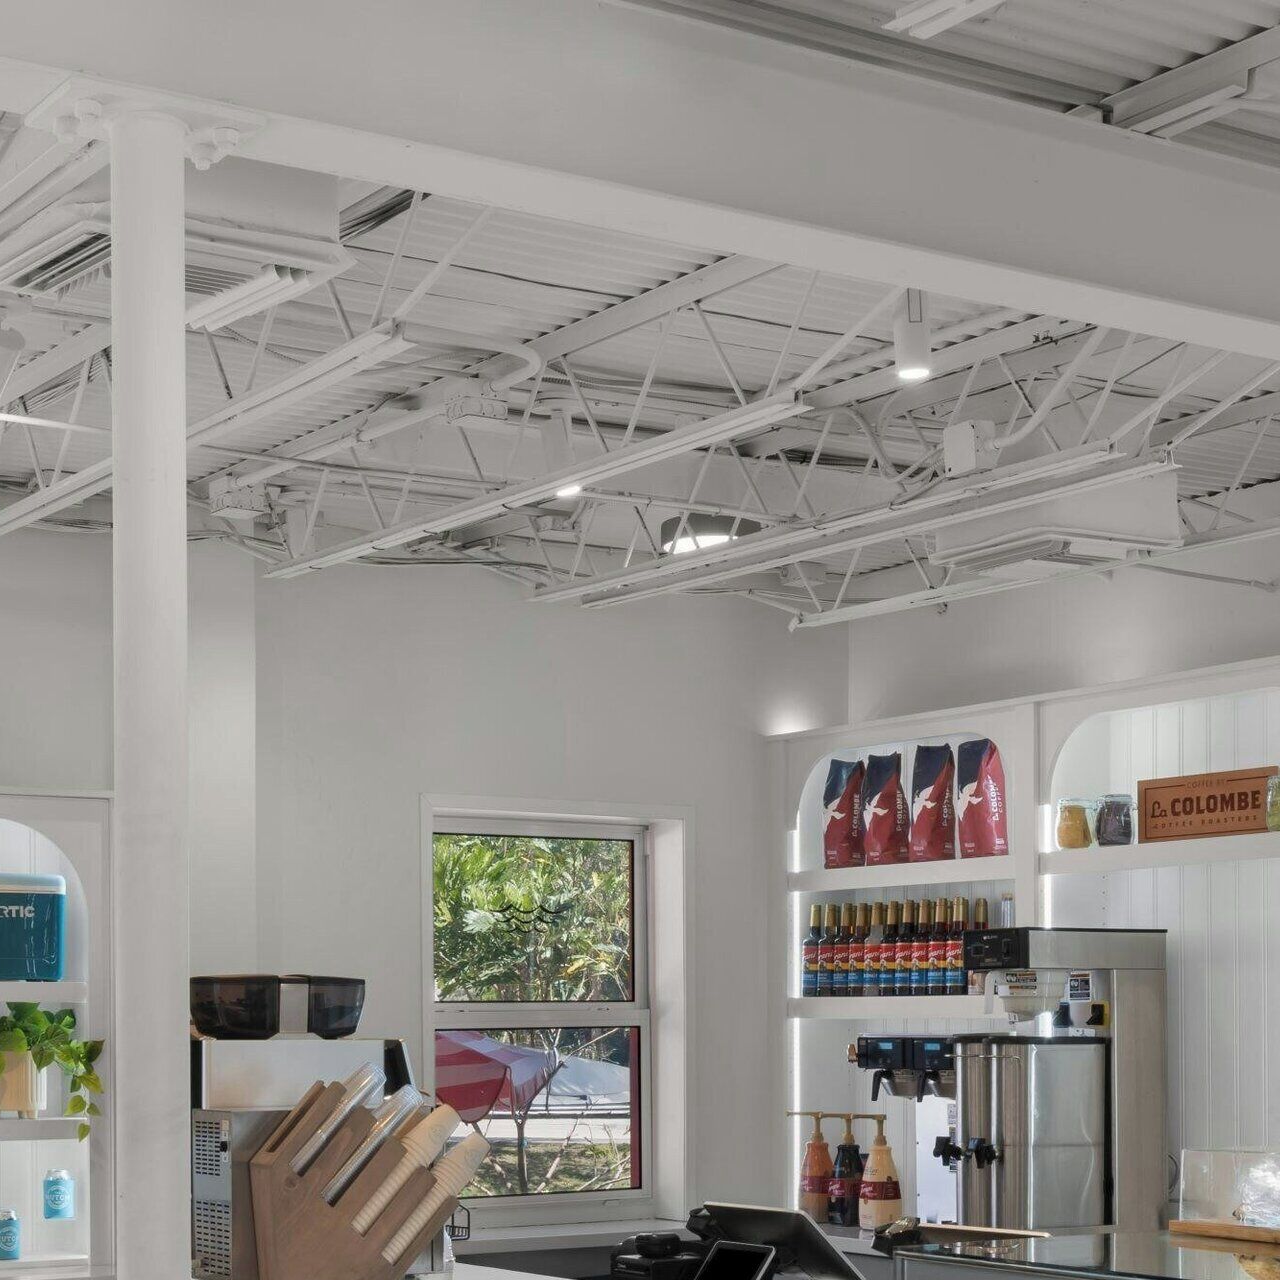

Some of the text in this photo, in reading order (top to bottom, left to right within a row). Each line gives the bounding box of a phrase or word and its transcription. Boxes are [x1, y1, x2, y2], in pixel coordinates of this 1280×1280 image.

[1150, 790, 1261, 819] La COLOMBE
[1201, 815, 1258, 826] ROASTERS
